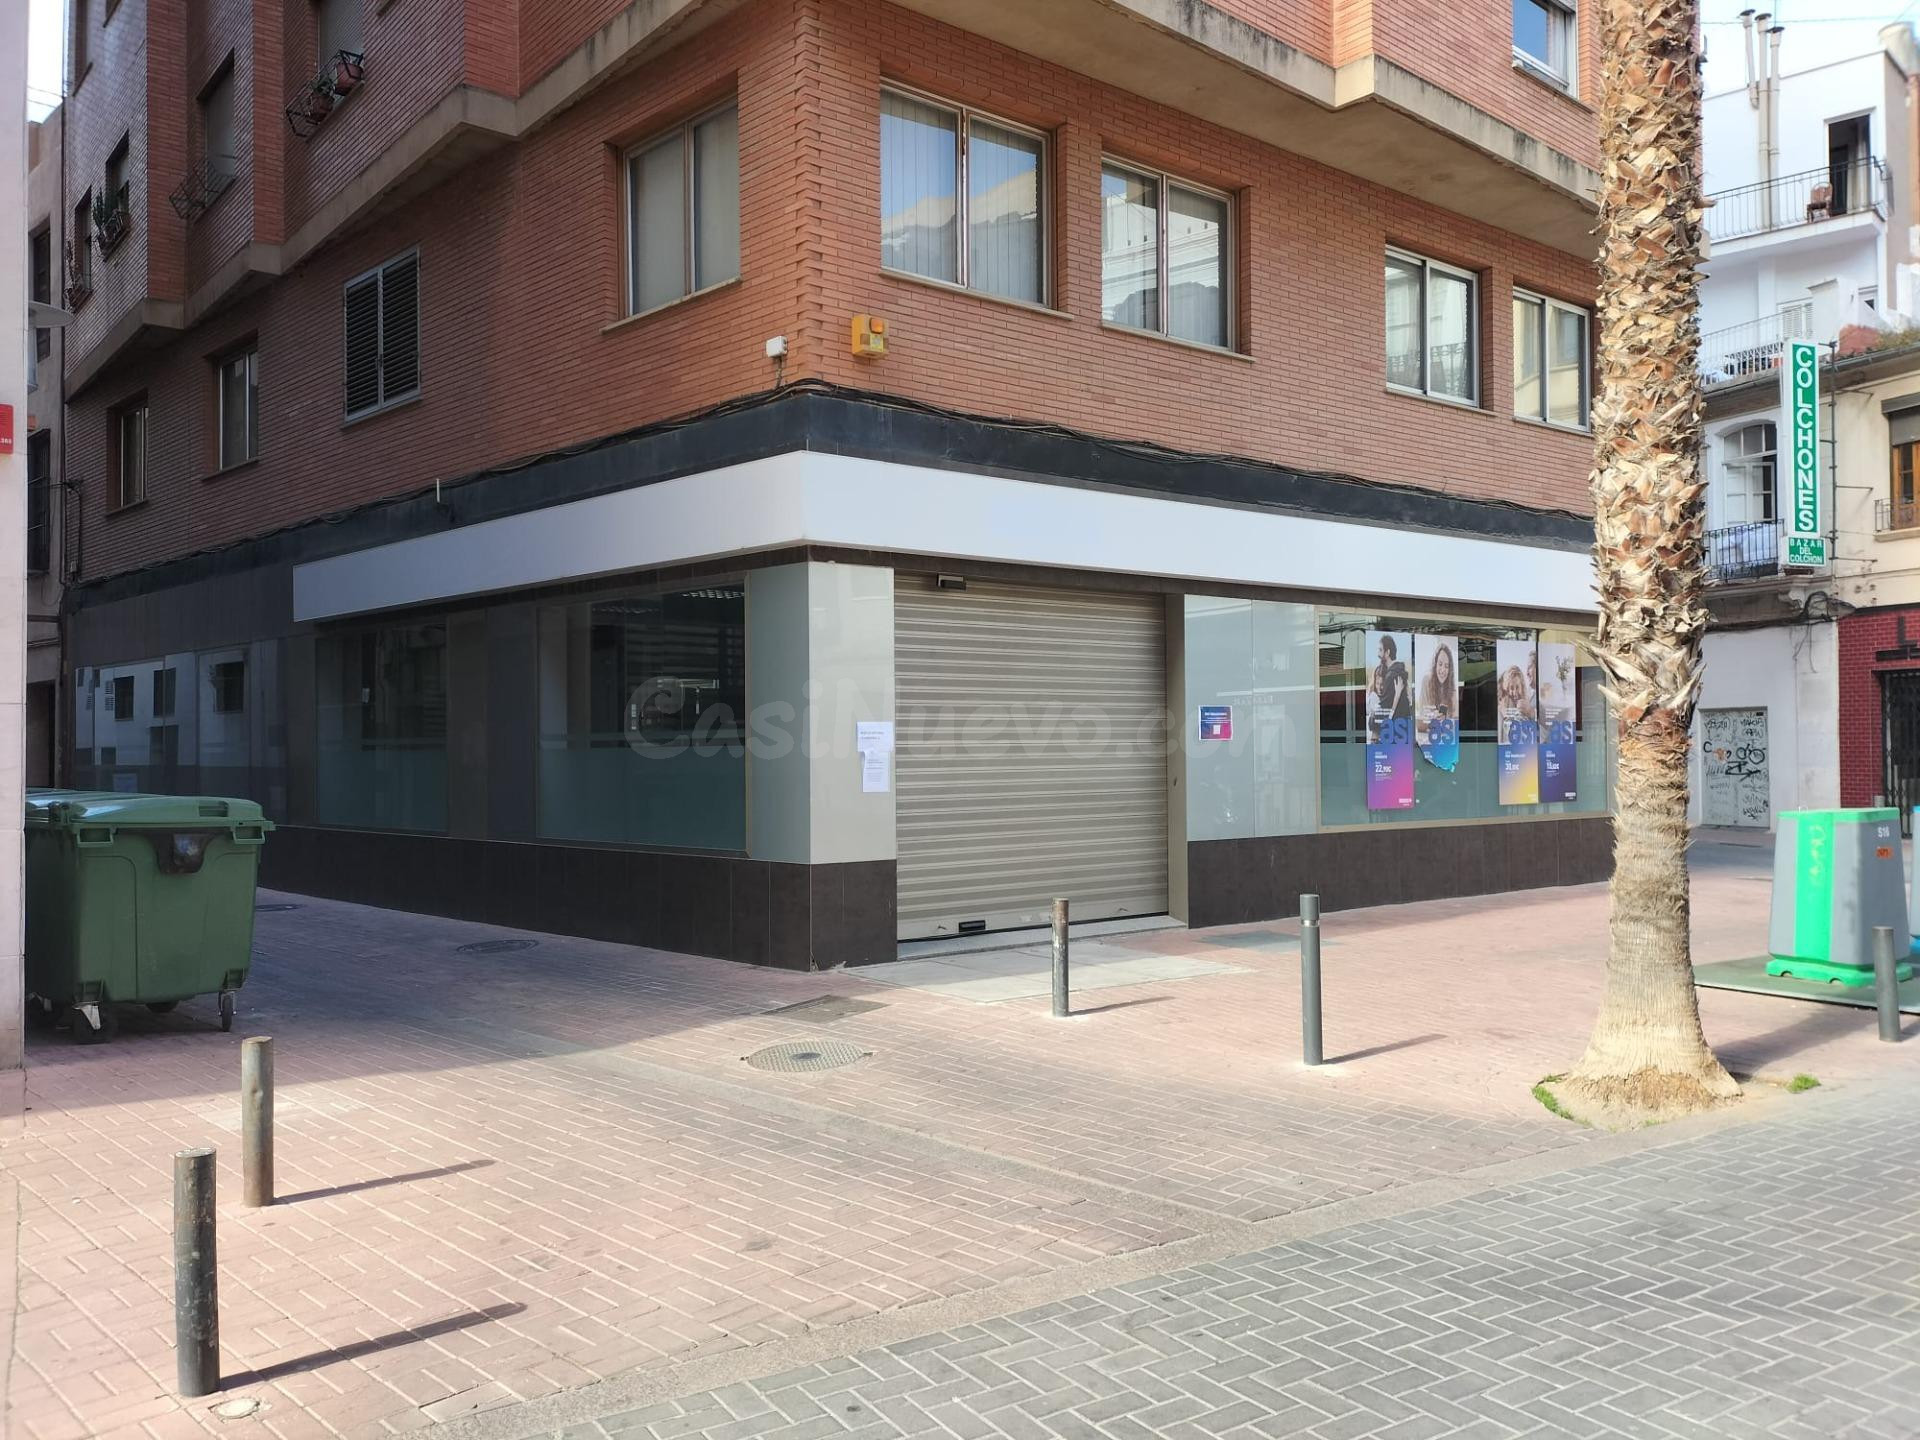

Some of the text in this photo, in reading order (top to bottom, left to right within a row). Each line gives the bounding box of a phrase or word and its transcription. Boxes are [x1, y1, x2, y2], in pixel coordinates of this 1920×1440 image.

[1796, 347, 1815, 532] COLCHONES
[1789, 538, 1823, 548] BAZAR
[1799, 546, 1812, 555] DEL
[1789, 554, 1823, 564] COLCHON
